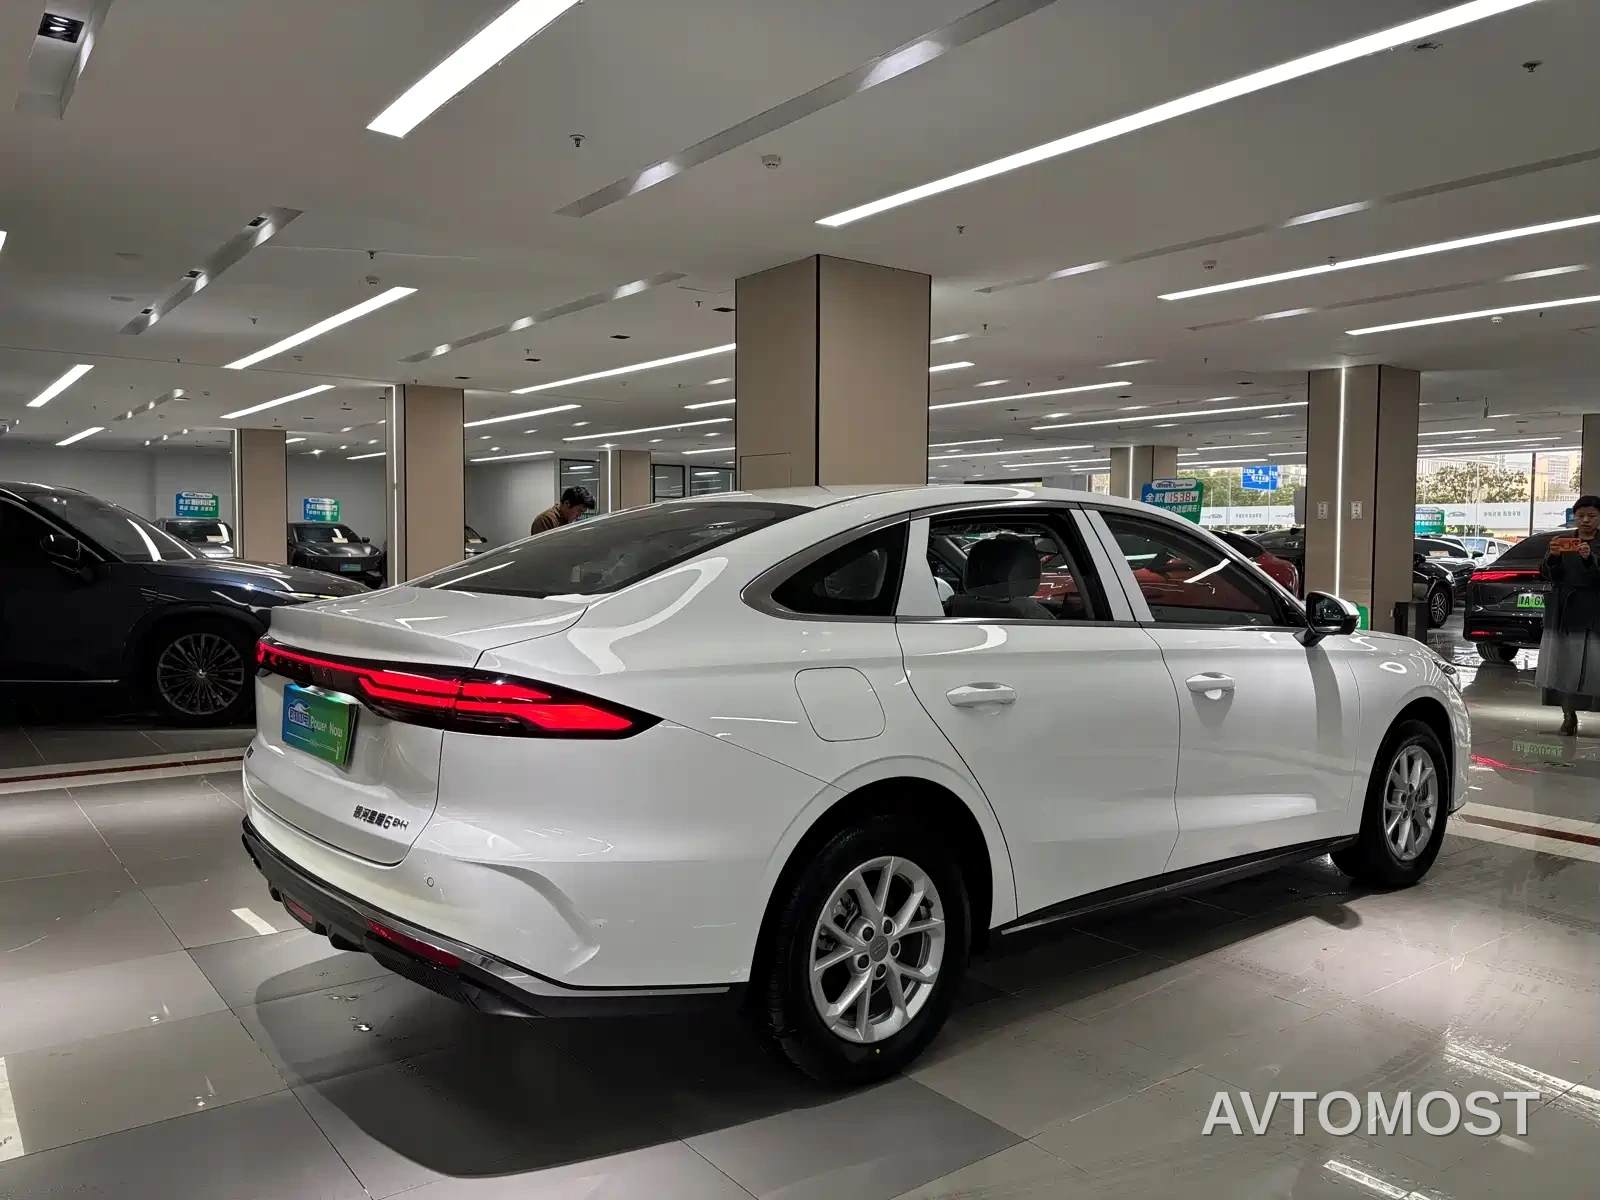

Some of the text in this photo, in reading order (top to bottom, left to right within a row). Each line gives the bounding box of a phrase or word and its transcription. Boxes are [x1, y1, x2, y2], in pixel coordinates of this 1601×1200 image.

[1145, 492, 1164, 503] 全款
[310, 715, 327, 732] Power
[329, 721, 343, 738] Now
